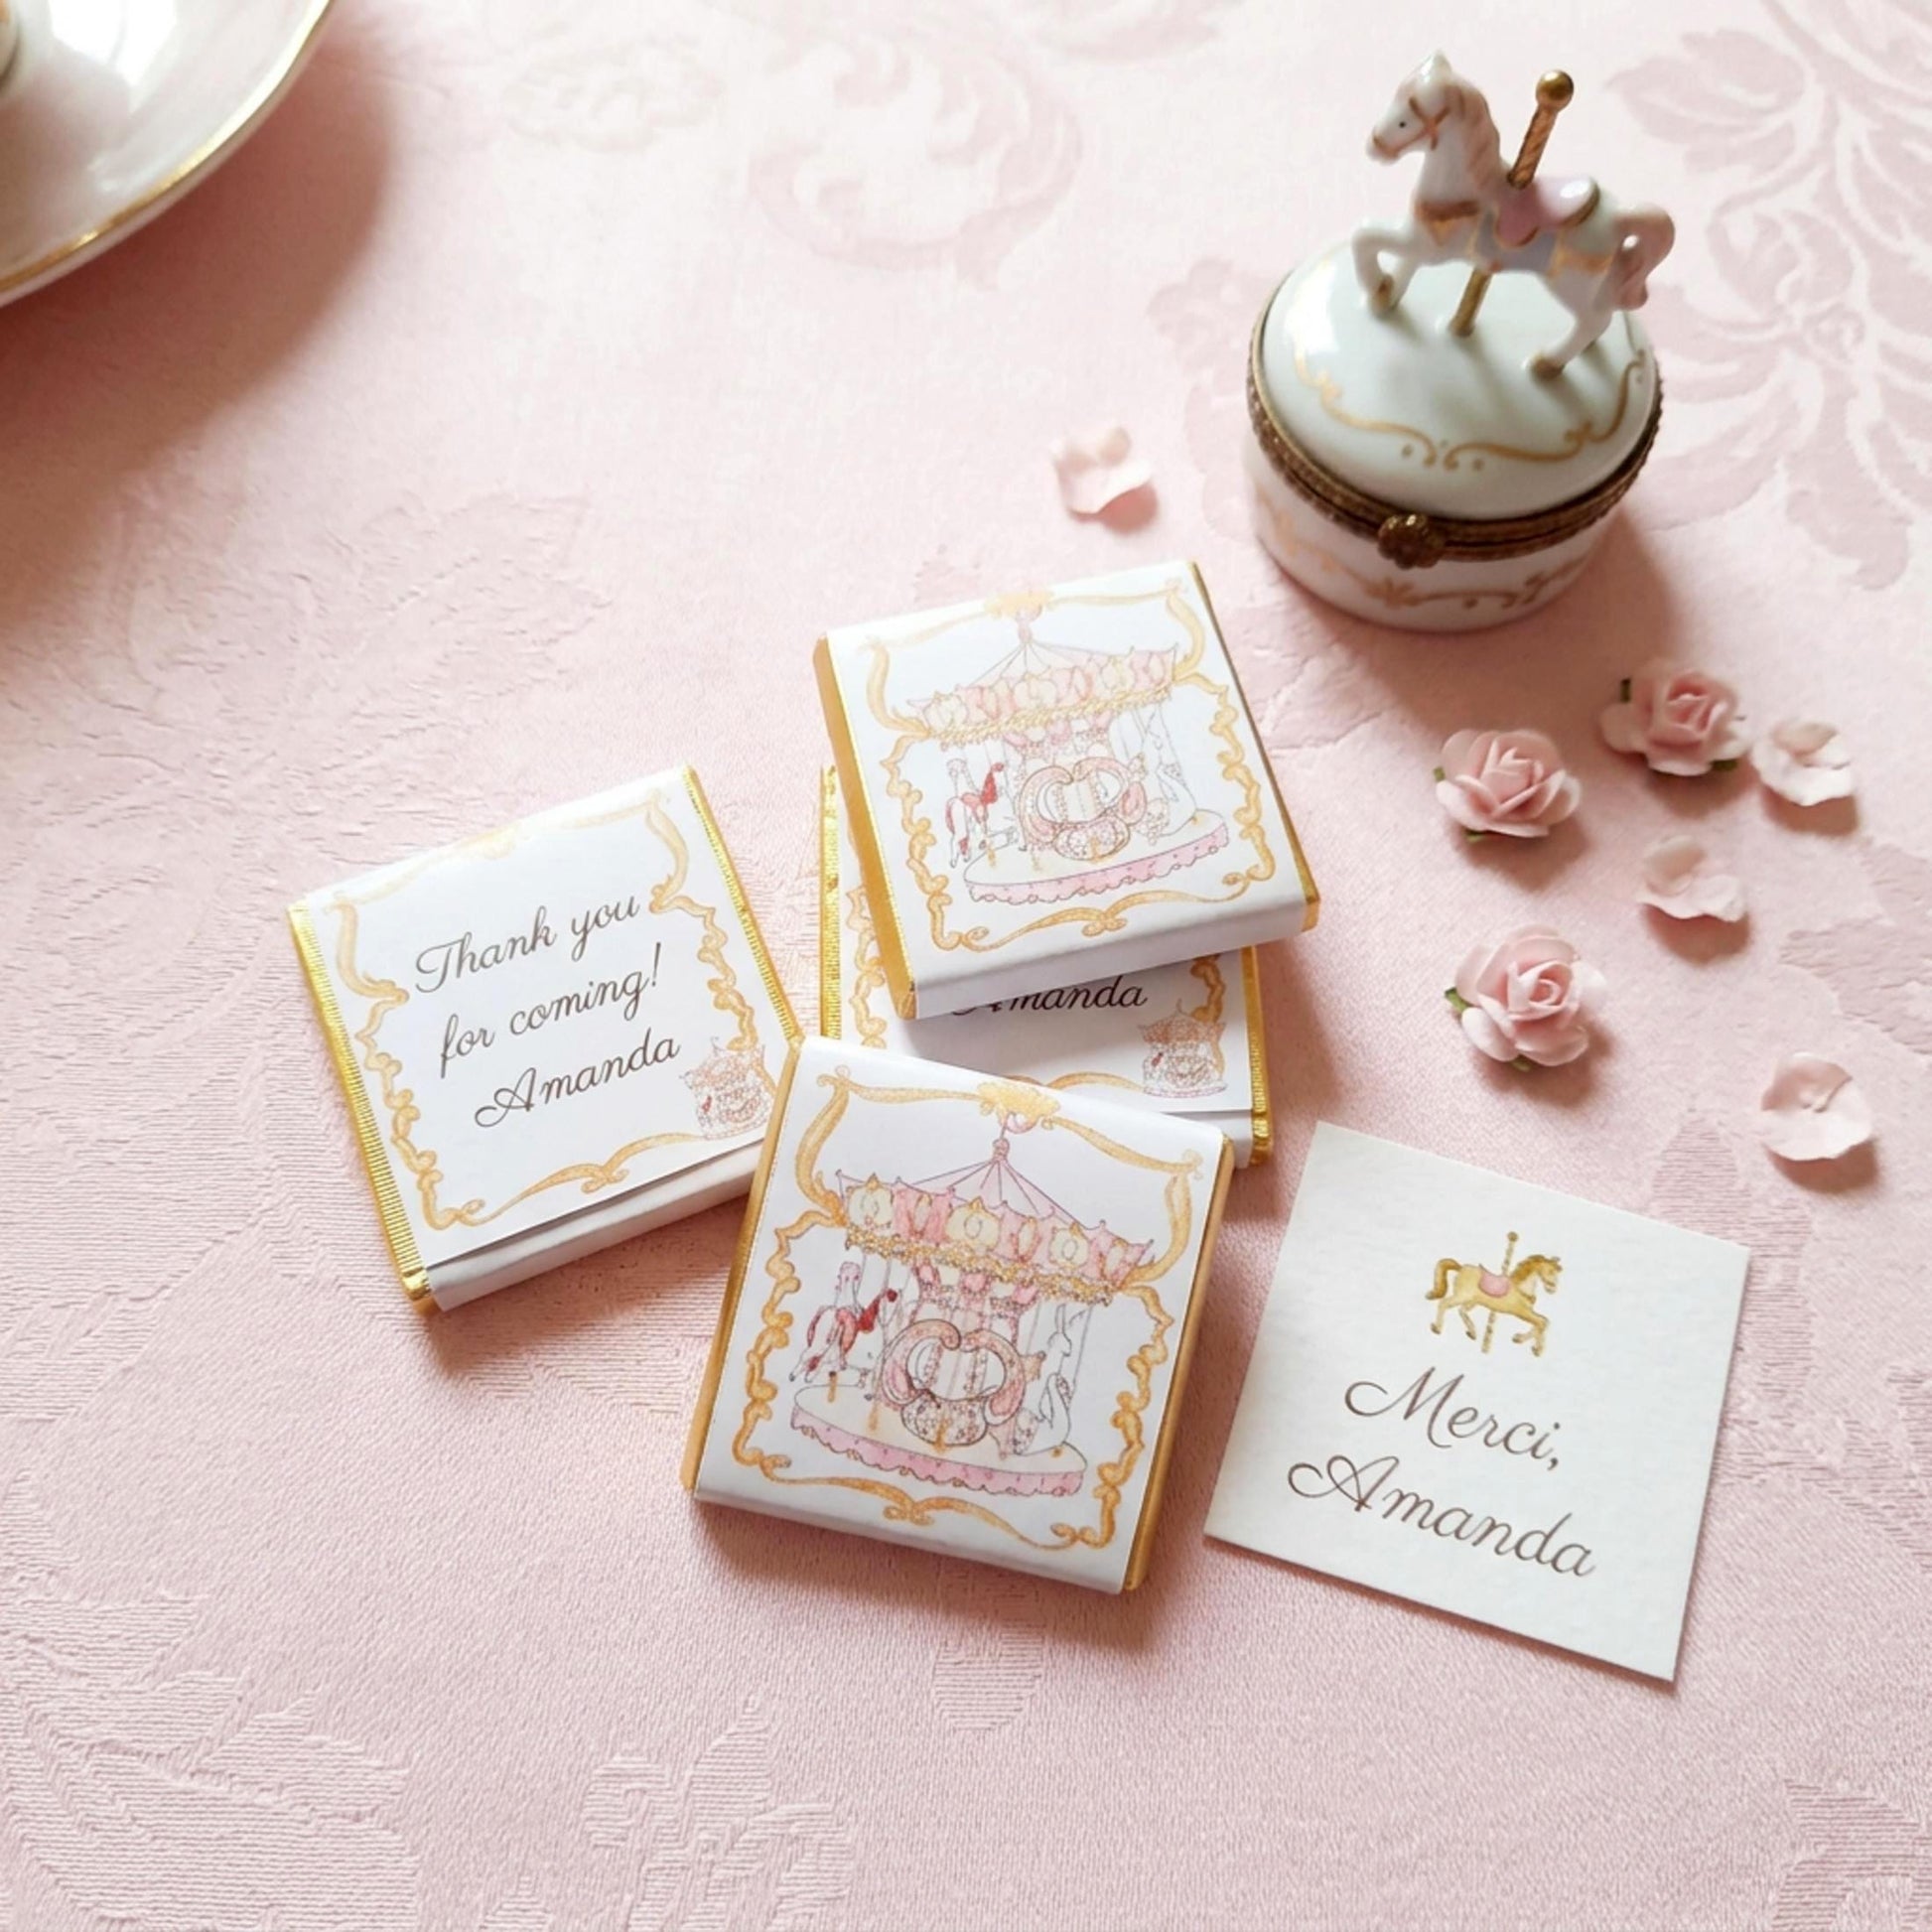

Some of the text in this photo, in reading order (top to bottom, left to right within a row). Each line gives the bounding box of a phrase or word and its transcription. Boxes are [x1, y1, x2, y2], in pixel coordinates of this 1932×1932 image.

[415, 897, 640, 993] Thank you
[952, 976, 1148, 1016] manda
[440, 942, 662, 1078] for coming!
[475, 1028, 680, 1128] Amanda
[1345, 1366, 1561, 1471] Merci,
[1287, 1455, 1595, 1577] Amanda
